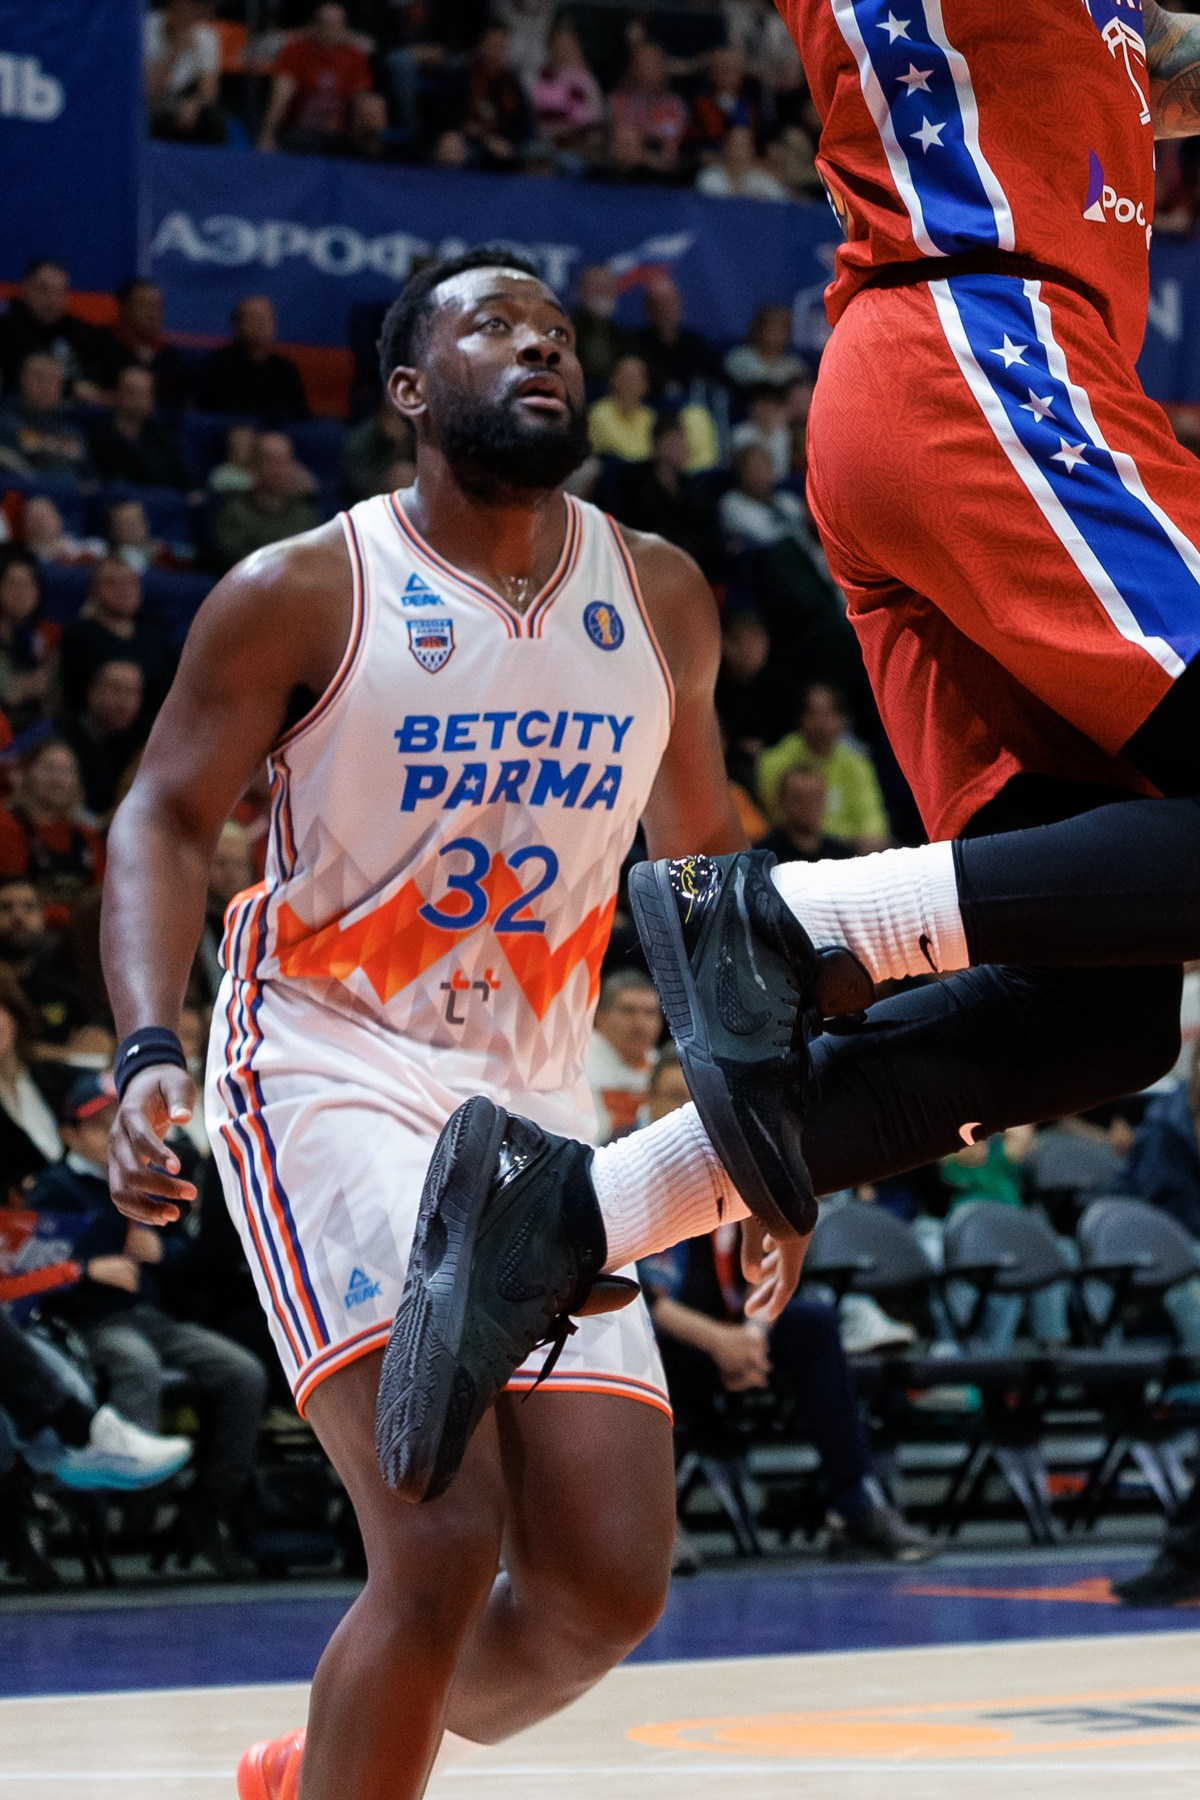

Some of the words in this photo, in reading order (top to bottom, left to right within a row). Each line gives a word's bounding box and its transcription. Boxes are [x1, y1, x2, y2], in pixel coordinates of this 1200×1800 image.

[394, 710, 635, 754] BETCITY
[400, 757, 623, 812] PARMA
[418, 836, 560, 933] 32
